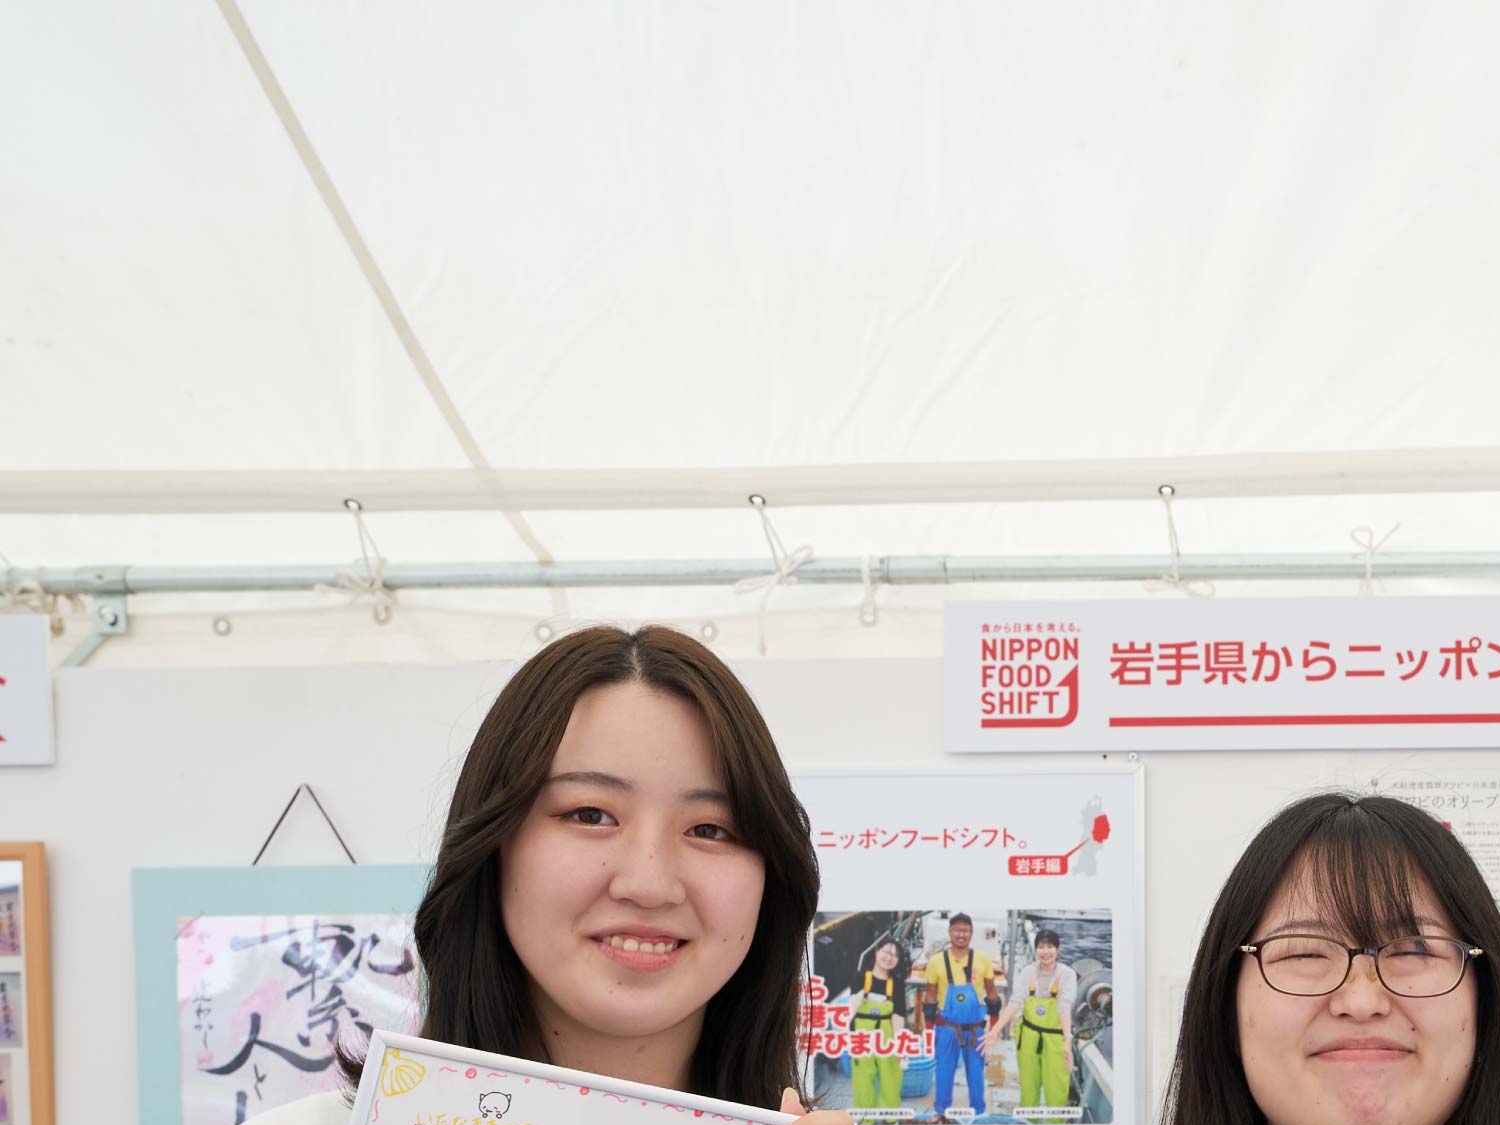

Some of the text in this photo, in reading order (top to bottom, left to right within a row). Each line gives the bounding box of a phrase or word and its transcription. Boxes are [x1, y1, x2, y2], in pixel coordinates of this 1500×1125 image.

[981, 622, 1081, 633] 食から日本を考える。
[981, 637, 1079, 661] NIPPON
[981, 664, 1052, 688] FOOD
[981, 691, 1060, 715] SHIFT
[1015, 859, 1061, 874] 岩手編
